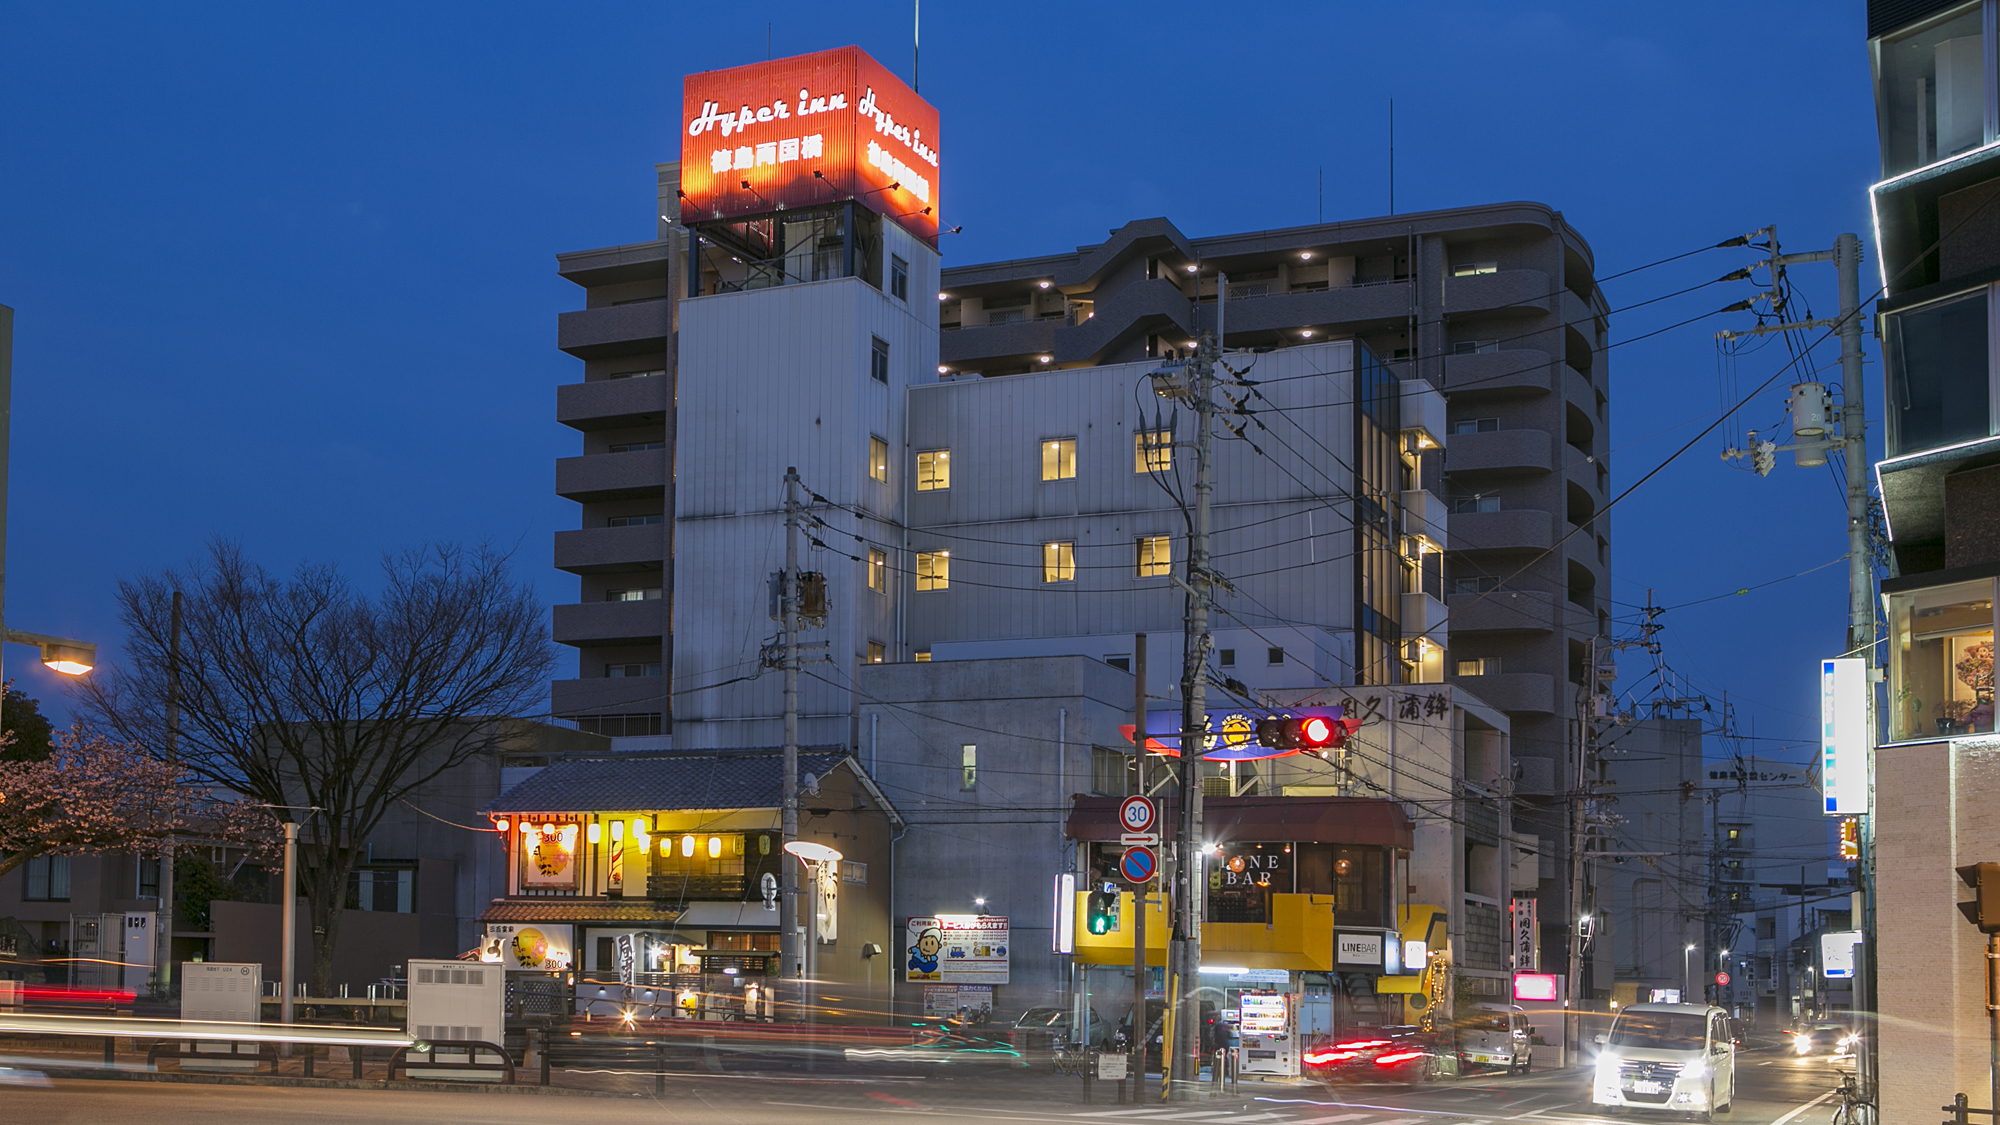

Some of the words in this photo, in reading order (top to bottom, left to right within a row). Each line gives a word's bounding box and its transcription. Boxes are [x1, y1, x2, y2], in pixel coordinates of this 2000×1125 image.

[688, 100, 790, 137] Hyper
[797, 88, 848, 116] inn
[858, 86, 912, 148] Hyper
[912, 128, 939, 168] inn
[1127, 806, 1147, 823] 30
[1227, 872, 1272, 886] BAR
